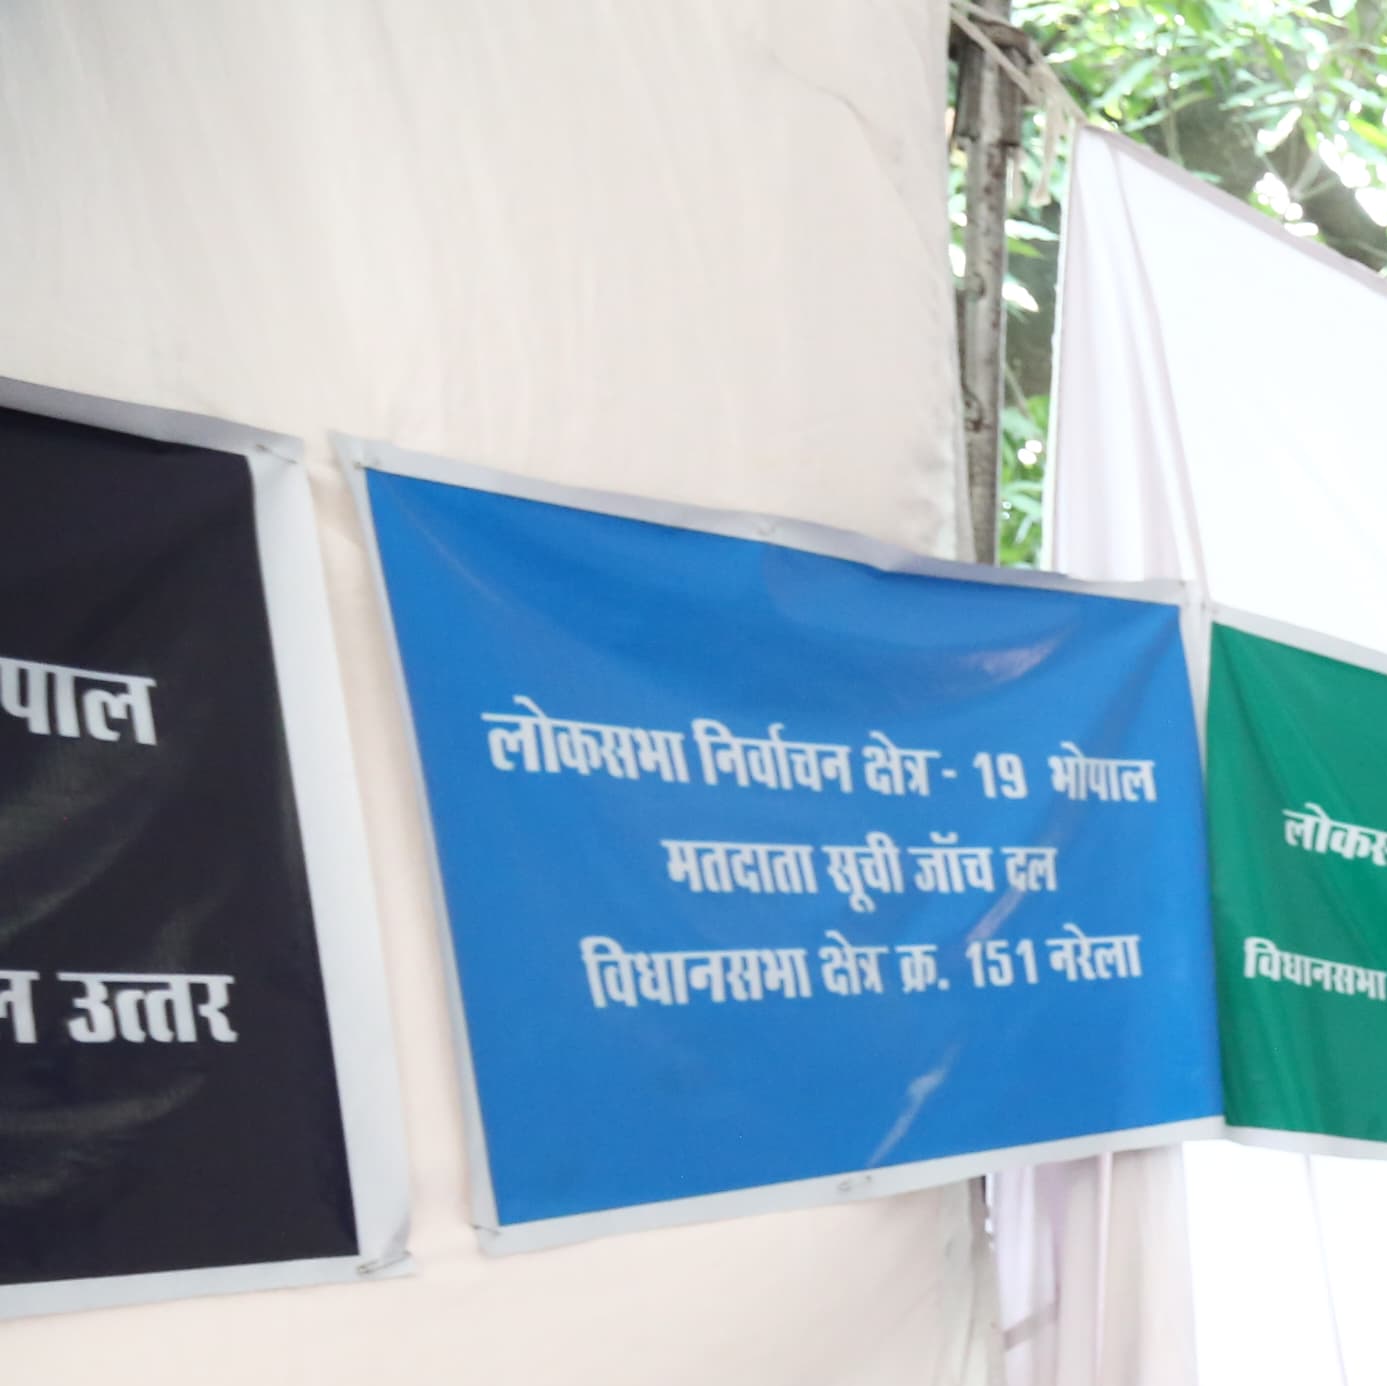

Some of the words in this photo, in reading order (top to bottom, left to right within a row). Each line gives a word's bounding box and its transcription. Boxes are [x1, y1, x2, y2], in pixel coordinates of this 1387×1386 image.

[480, 695, 690, 783] लोकसभा
[691, 718, 852, 794] निर्वाचन
[973, 752, 1028, 799] 19
[1048, 741, 1157, 802] भोपाल
[660, 839, 817, 894] मतदाता
[821, 831, 905, 912] सूची
[1001, 846, 1058, 893] दल
[579, 935, 812, 1008] विधानसभा
[818, 930, 889, 996] क्षेत्र
[896, 944, 949, 993] क्र.
[966, 939, 1038, 988] 151
[1045, 923, 1143, 982] नरेला
[1243, 936, 1387, 1001] विधानसभा
[57, 971, 239, 1043] उत्तर
